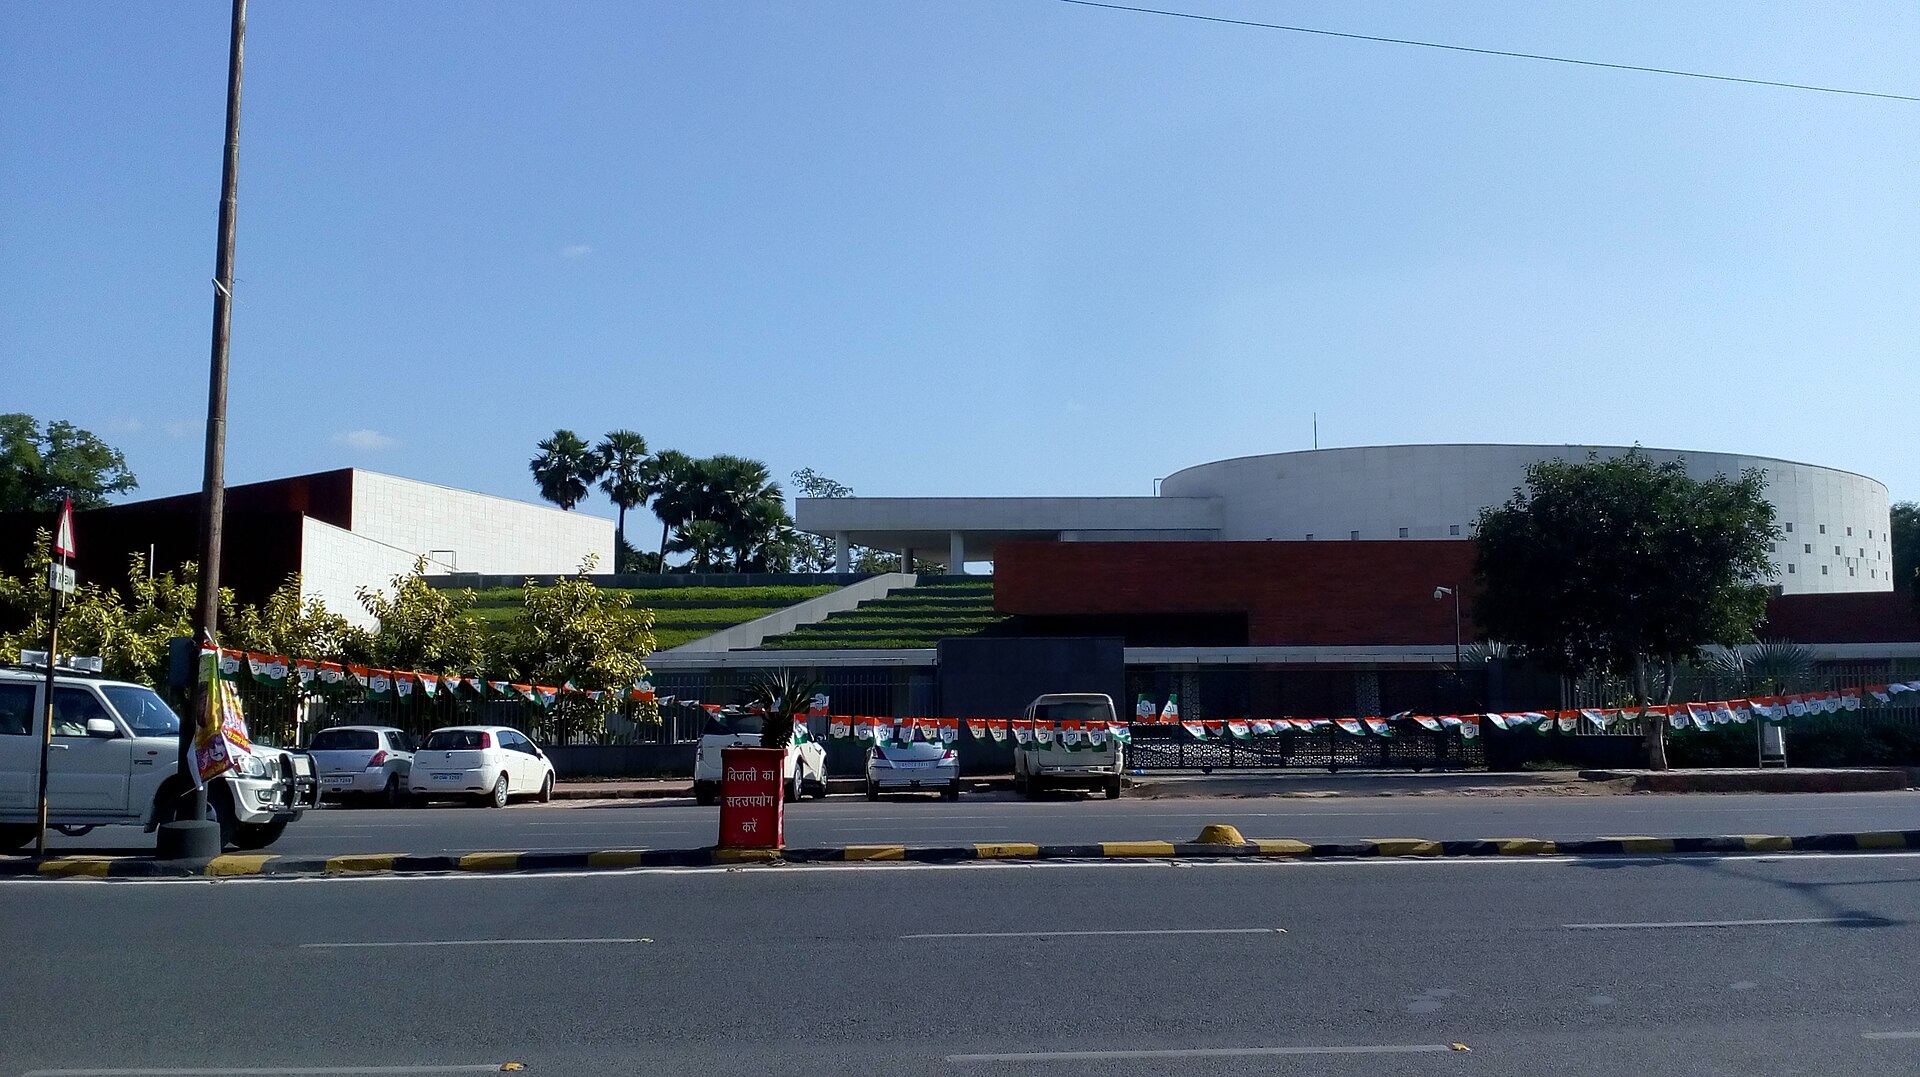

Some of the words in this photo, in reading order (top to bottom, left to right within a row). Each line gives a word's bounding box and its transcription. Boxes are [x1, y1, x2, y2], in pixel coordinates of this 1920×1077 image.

[762, 770, 775, 781] का
[726, 792, 774, 807] सदउपयोग
[742, 817, 758, 832] करें
